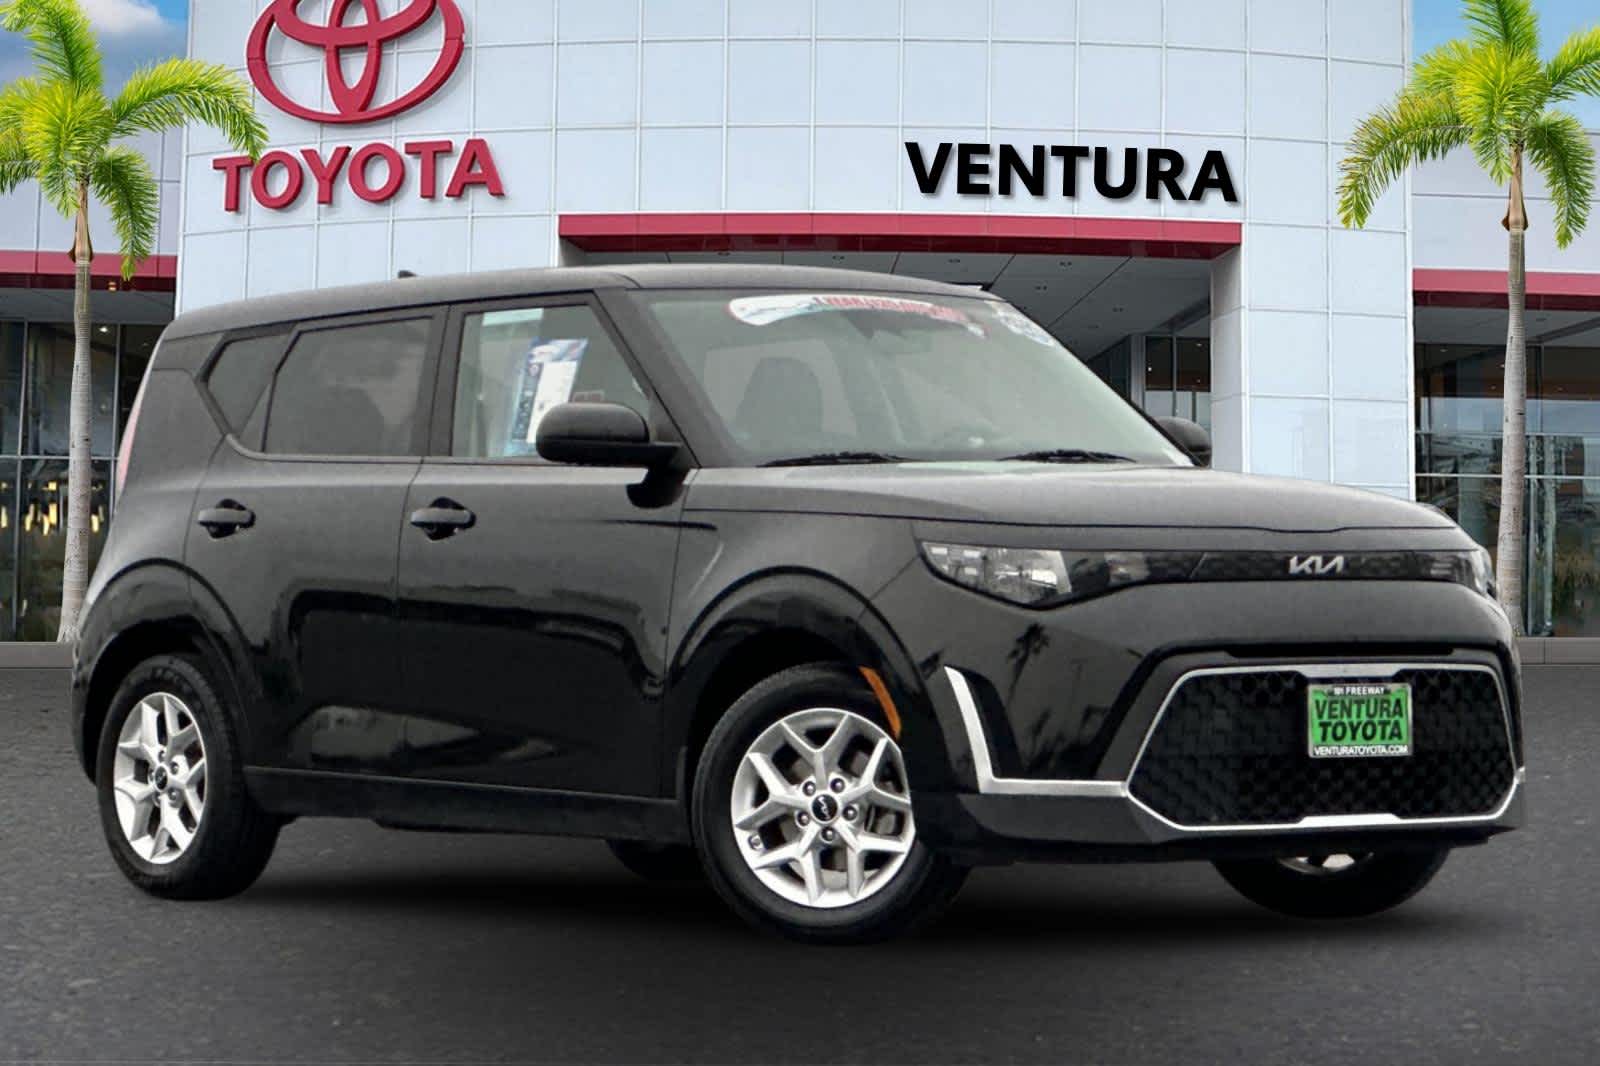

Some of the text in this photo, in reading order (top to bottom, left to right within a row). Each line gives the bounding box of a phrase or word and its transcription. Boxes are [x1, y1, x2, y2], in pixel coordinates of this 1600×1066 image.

[212, 138, 505, 212] TOYOTA
[904, 141, 1239, 203] VENTURA
[1289, 555, 1345, 575] KIA
[1345, 686, 1385, 696] FREEWAY
[1314, 699, 1404, 719] VENTURA
[1318, 721, 1403, 742] TOYOTA
[1314, 745, 1409, 756] VENTURATOYOTA.COM
